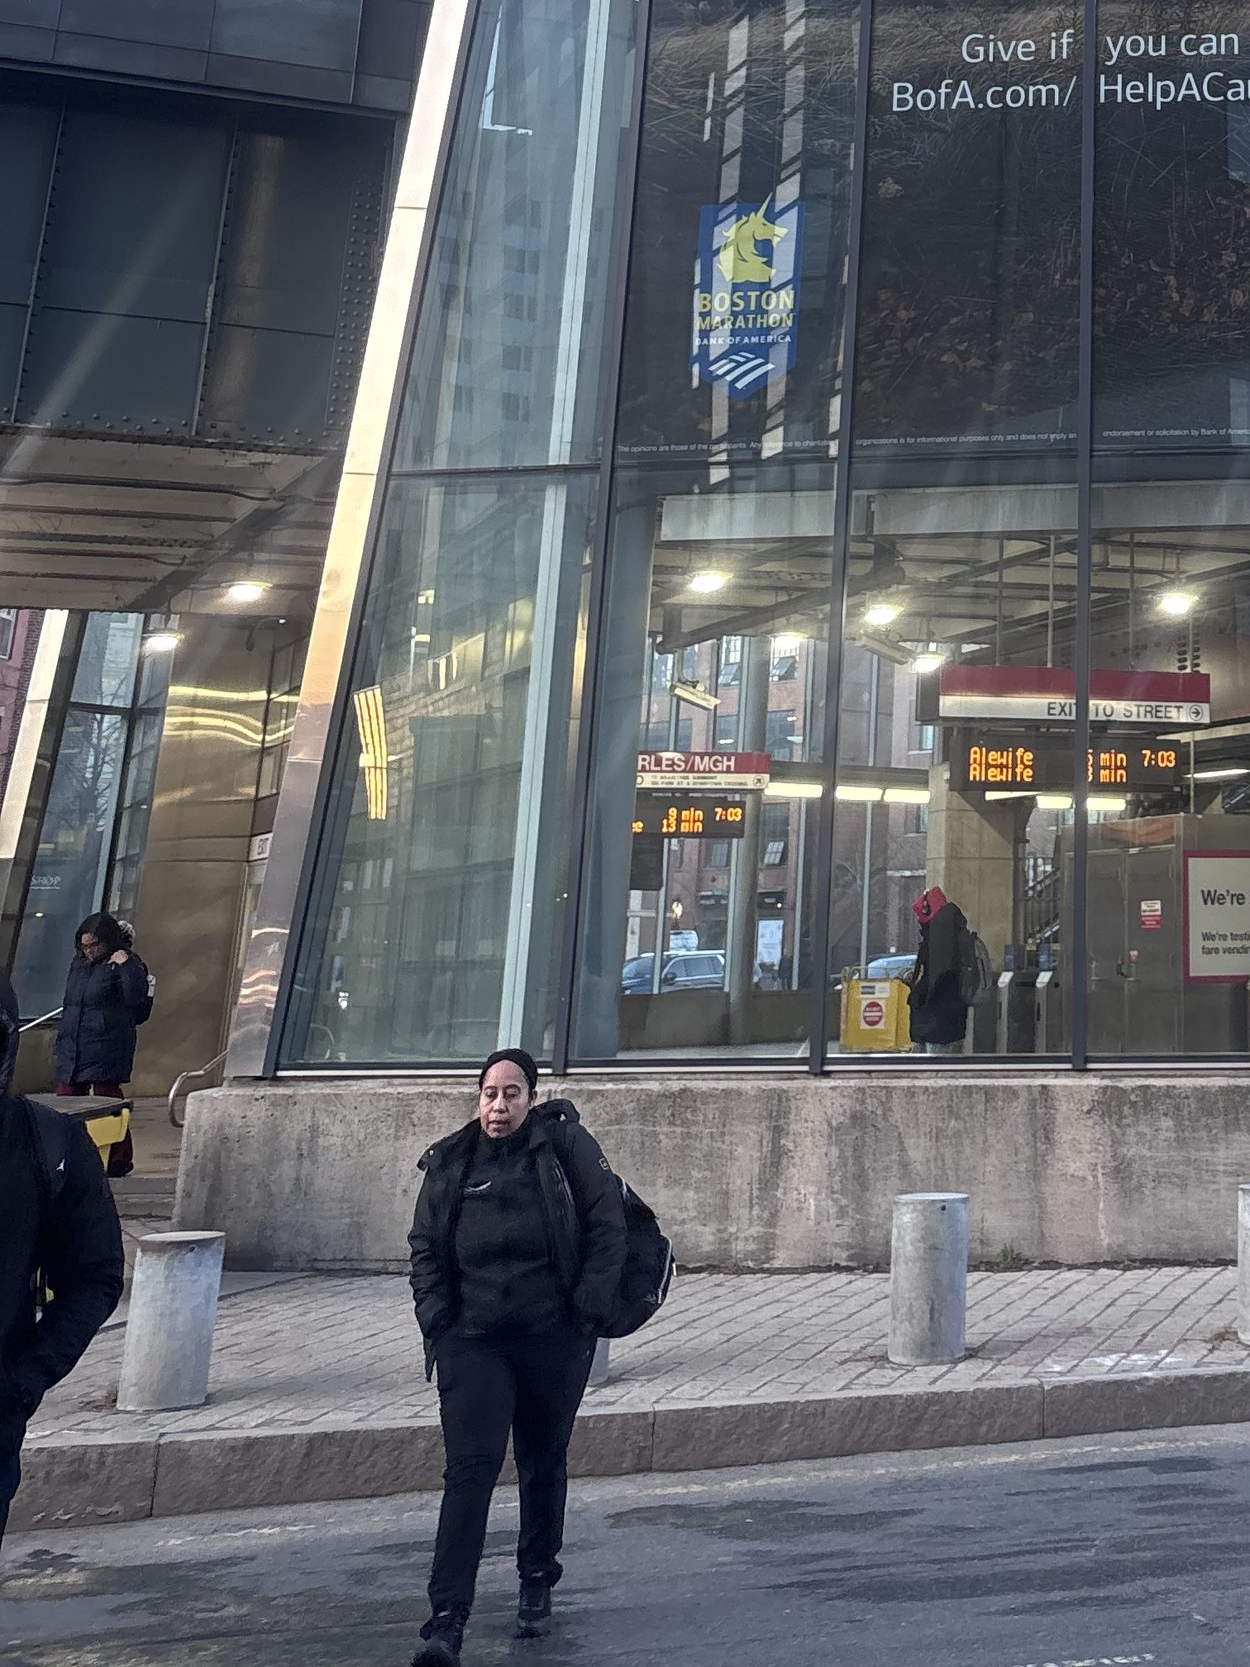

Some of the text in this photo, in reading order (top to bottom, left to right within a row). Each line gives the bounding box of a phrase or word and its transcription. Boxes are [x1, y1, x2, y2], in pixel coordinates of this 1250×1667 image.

[961, 29, 1240, 64] Give if you can
[892, 75, 1077, 112] BofA.com/
[698, 289, 795, 312] BOSTON
[695, 313, 793, 330] MARATHON
[695, 334, 792, 346] BANK OF AMERICA
[1047, 701, 1184, 719] EXI TO STREET
[969, 746, 1034, 765] Alewife
[1100, 749, 1126, 767] min
[1142, 750, 1176, 767] 7:03
[969, 764, 1034, 782] Alewife
[1100, 767, 1126, 783] min
[668, 807, 742, 822] 9 min 7:03
[662, 819, 703, 833] 13 min
[1201, 889, 1245, 905] We're
[1201, 945, 1220, 955] fare
